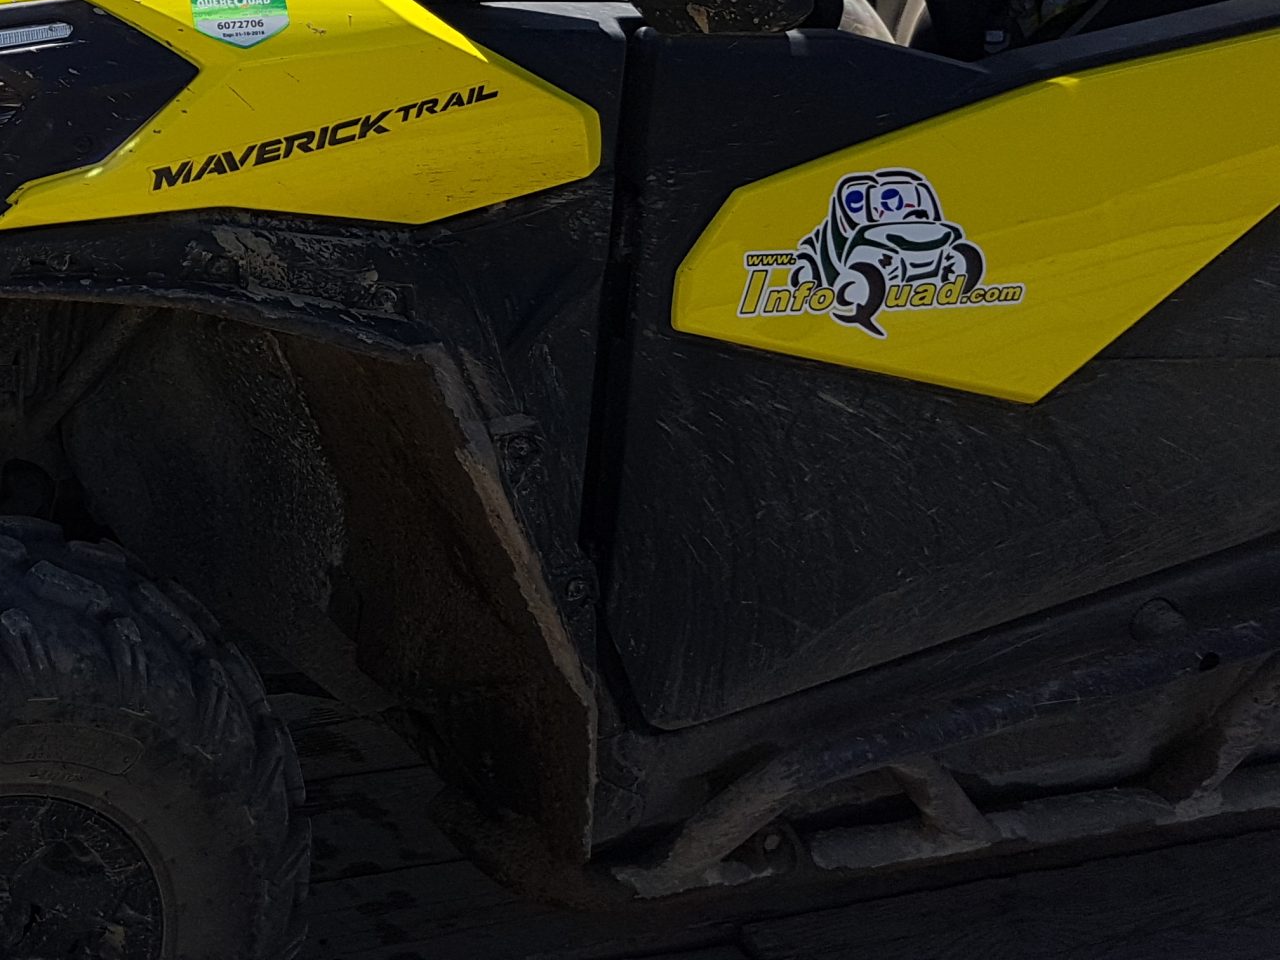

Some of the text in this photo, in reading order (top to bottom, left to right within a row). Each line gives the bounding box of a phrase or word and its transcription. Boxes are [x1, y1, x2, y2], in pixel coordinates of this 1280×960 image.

[217, 19, 265, 31] 6072706
[152, 84, 499, 191] MAVERICK TRAIL
[746, 253, 797, 267] www.
